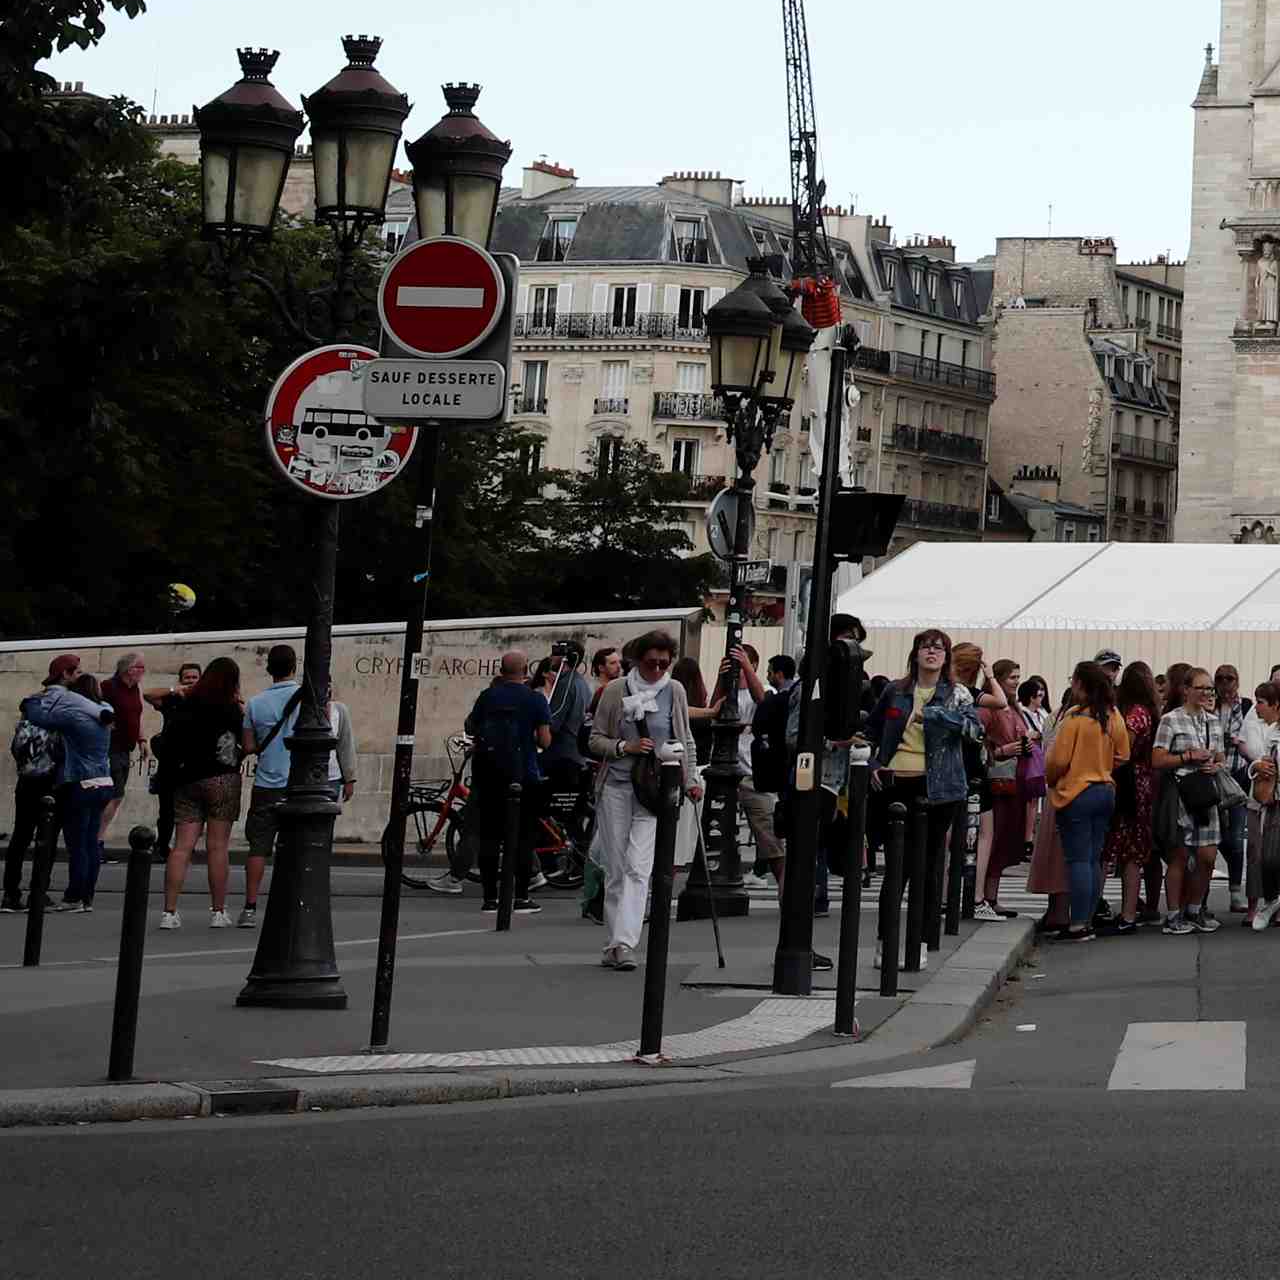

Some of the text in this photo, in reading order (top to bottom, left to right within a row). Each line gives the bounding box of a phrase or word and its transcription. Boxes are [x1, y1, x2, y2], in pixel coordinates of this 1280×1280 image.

[370, 371, 497, 386] SAUF DESSERTE
[402, 393, 462, 406] LOCALE
